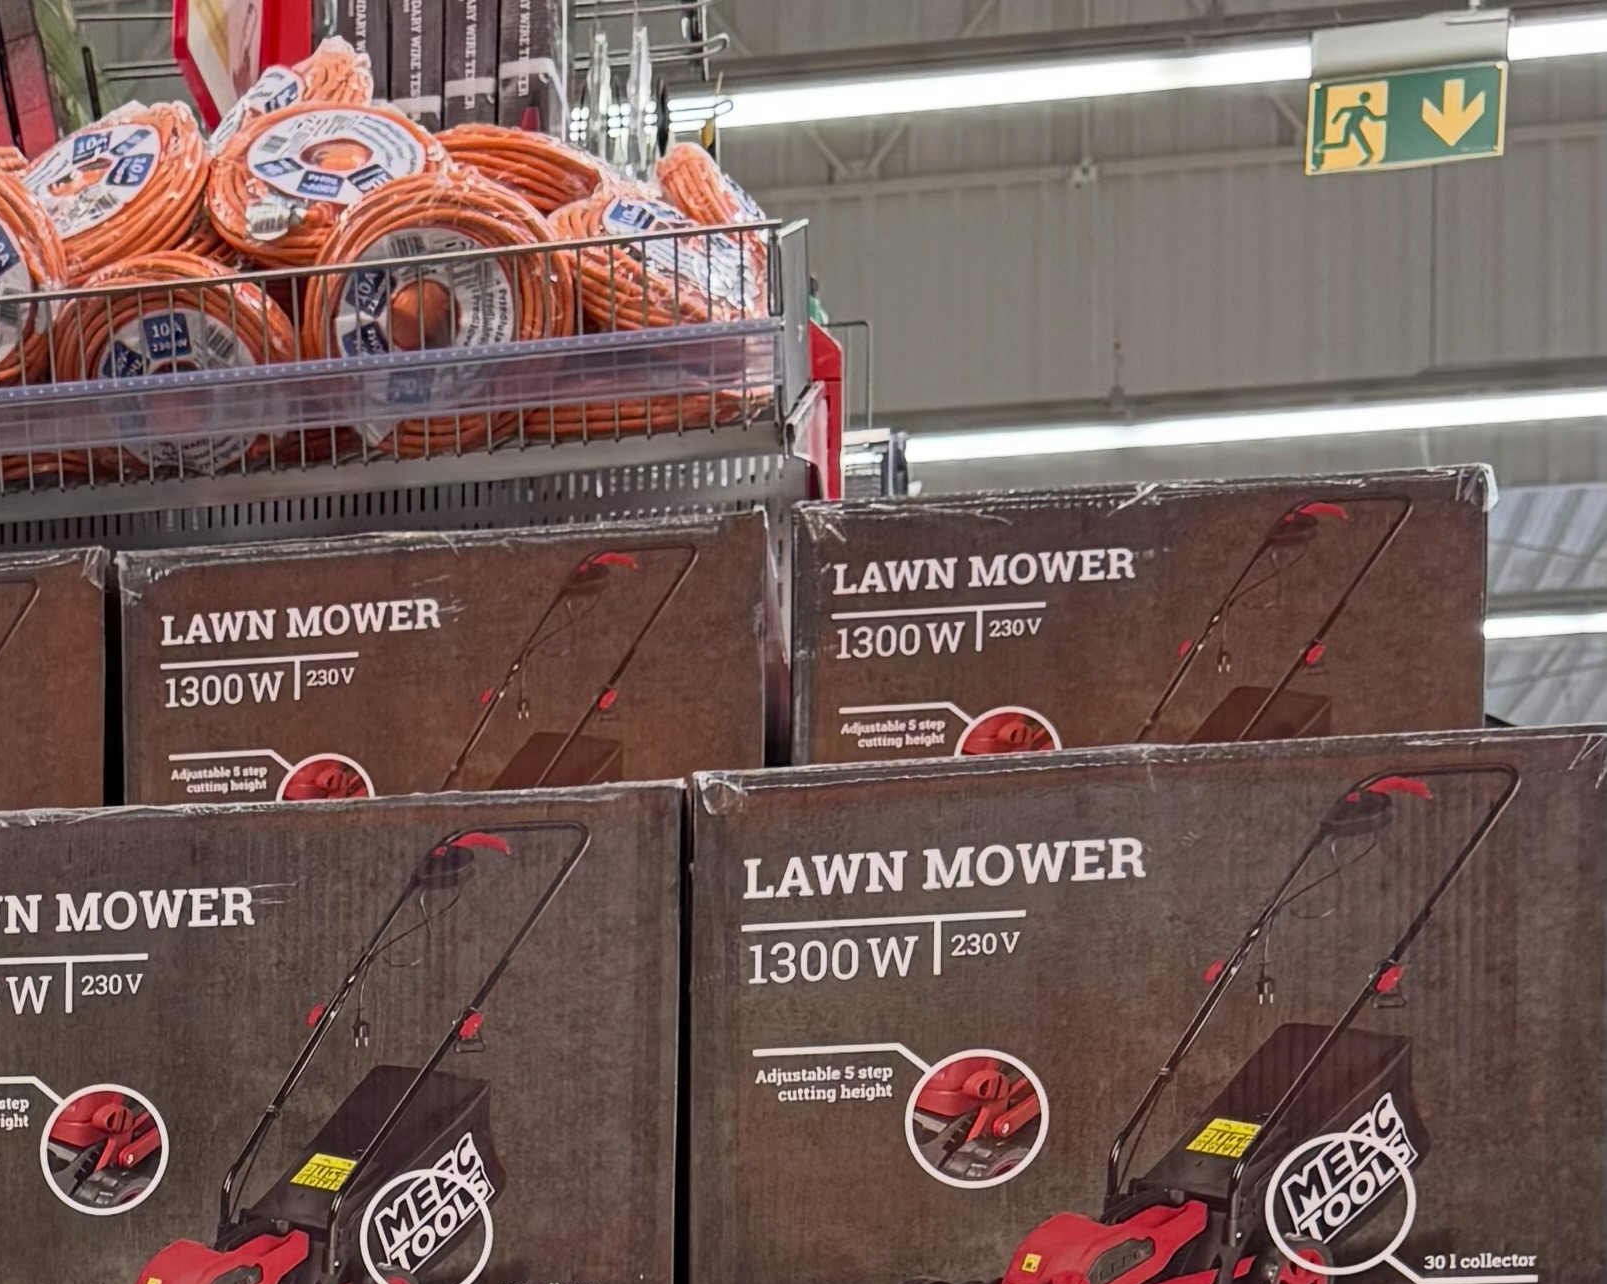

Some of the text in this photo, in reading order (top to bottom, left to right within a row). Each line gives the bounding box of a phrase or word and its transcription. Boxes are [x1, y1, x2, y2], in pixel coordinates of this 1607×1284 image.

[832, 547, 1136, 595] LAWN MOWER
[160, 598, 441, 646] LAWN MOWER
[840, 719, 946, 737] Adjustable 5 step
[857, 732, 945, 749] cutting height
[742, 837, 1147, 900] LAWN MOWER
[55, 886, 255, 933] MOWER
[755, 1065, 893, 1087] Adjustable 5 step
[777, 1082, 893, 1103] cutting height
[1284, 1094, 1399, 1224] MEEC
[376, 1134, 477, 1252] MEEC
[1423, 1254, 1446, 1270] 30
[1459, 1252, 1537, 1269] collector
